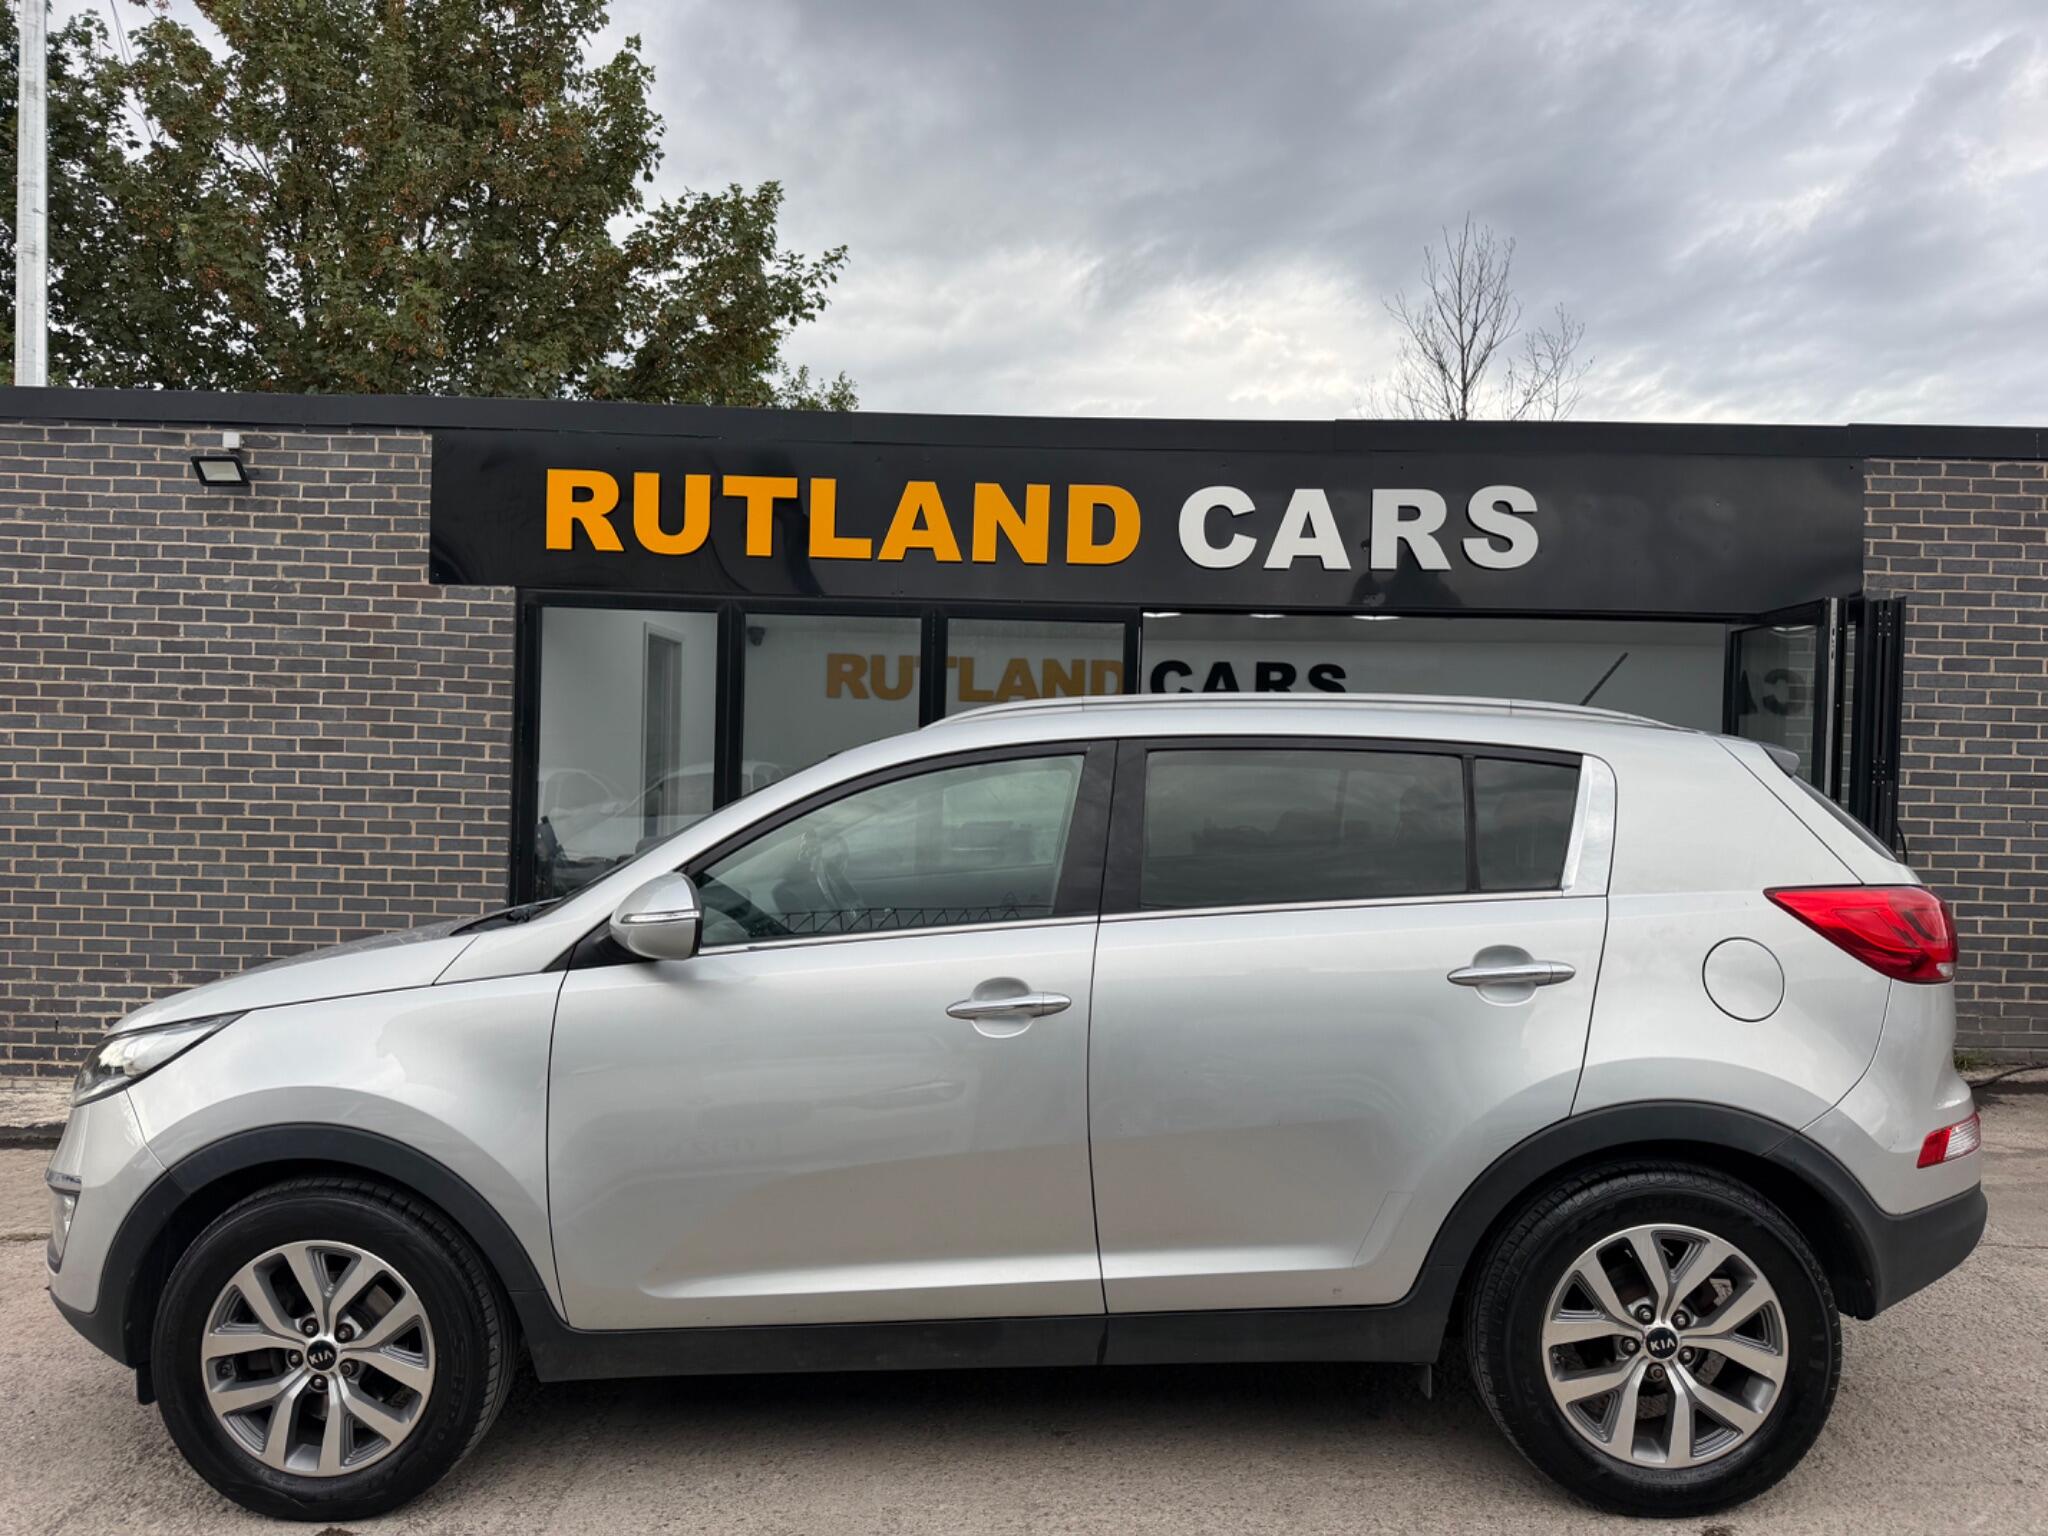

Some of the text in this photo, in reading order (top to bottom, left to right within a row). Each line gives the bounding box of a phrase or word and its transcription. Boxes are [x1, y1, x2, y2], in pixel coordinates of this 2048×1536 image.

[546, 468, 1539, 570] RUTLAND CARS
[826, 653, 1347, 703] RULAND CARS
[309, 1350, 334, 1365] KIA
[1650, 1337, 1676, 1351] KIA
